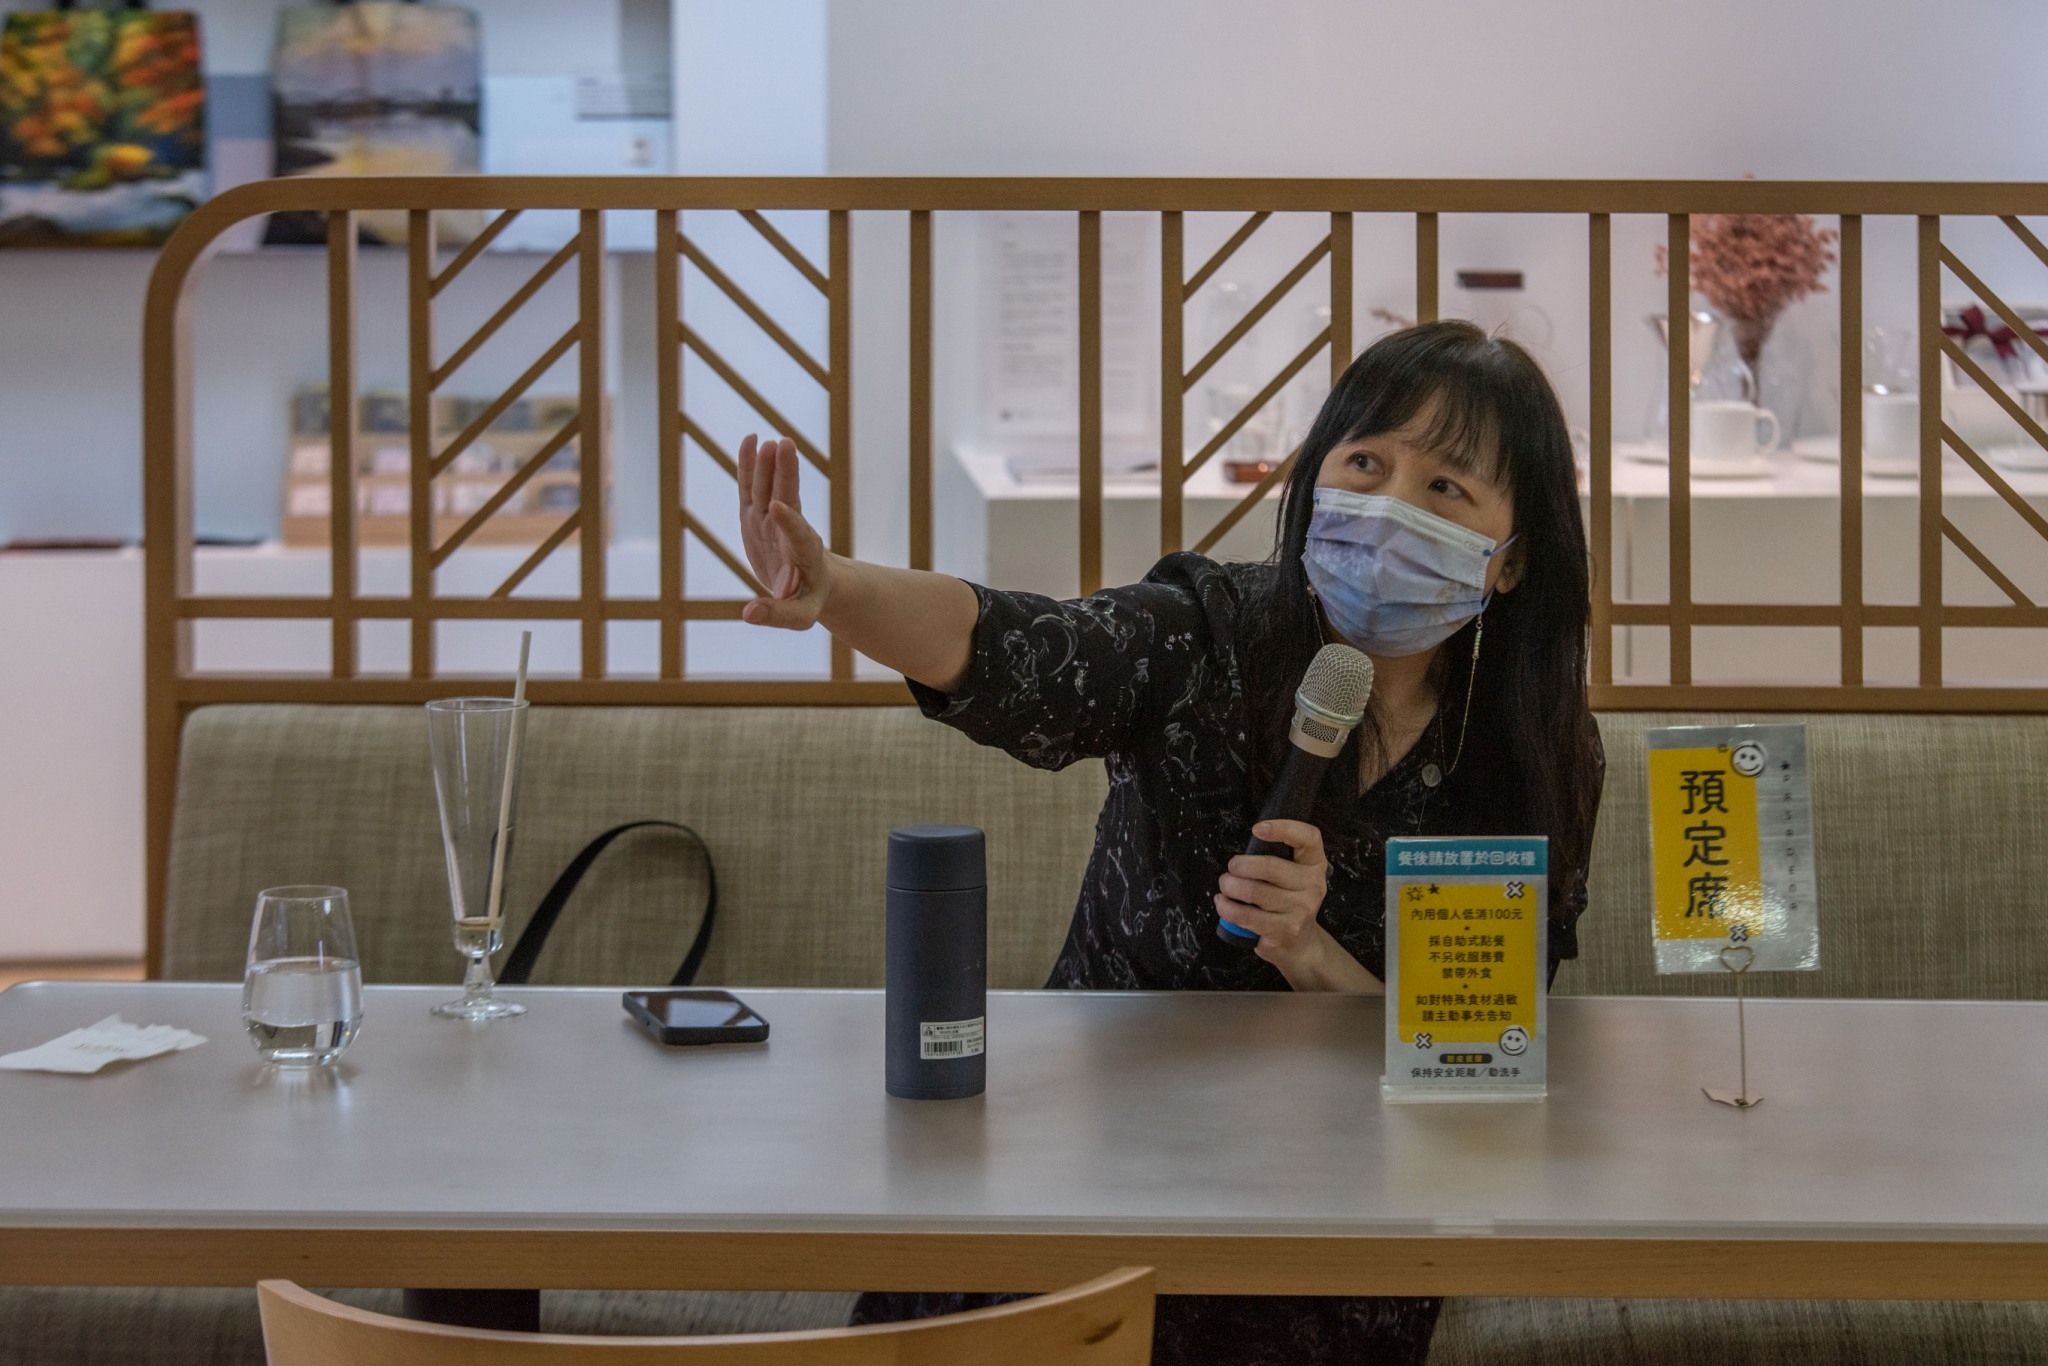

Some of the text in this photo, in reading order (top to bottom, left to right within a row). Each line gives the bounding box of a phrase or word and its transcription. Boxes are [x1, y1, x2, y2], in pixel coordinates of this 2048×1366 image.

[1679, 770, 1730, 919] 預定席
[1428, 935, 1505, 947] 採自助式點餐
[1428, 951, 1505, 963] 不另收服務費
[1441, 967, 1493, 979] 禁帶外食
[1416, 994, 1518, 1006] 如對特殊食材過敏
[1422, 1010, 1512, 1022] 請主動事先告知
